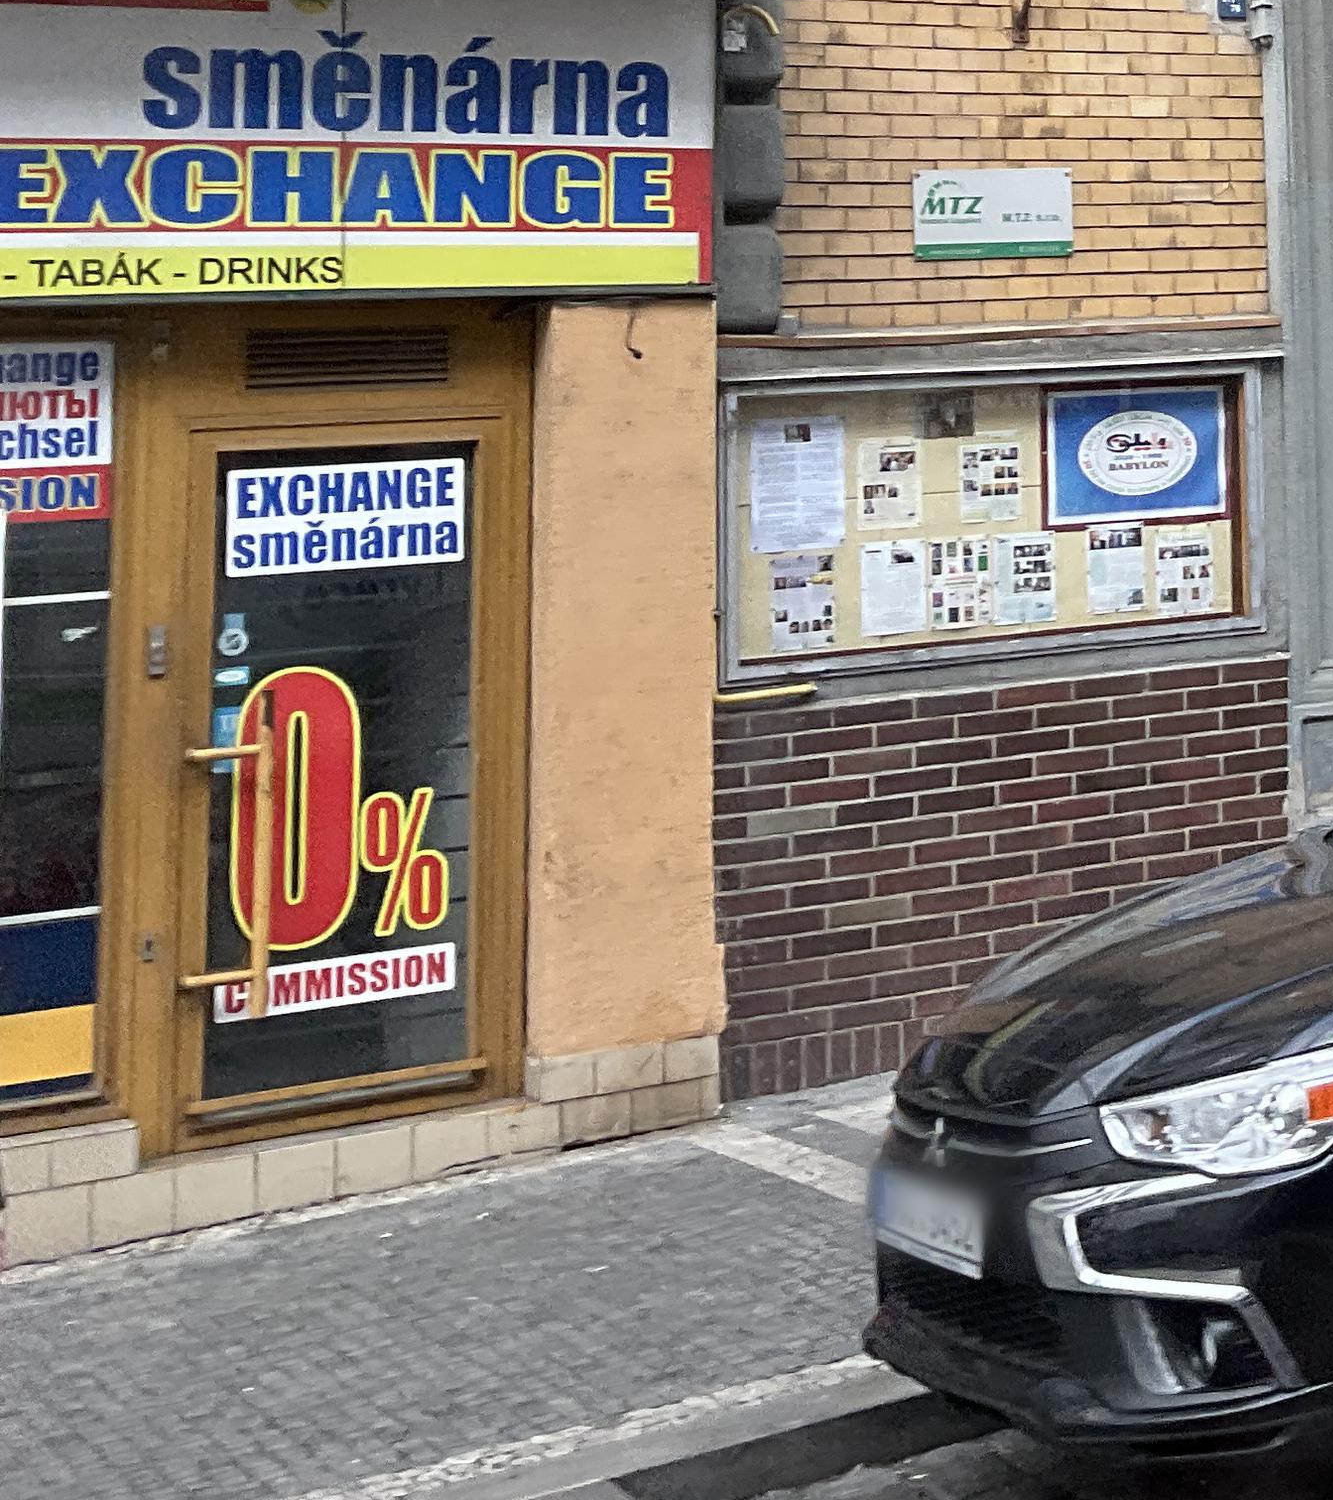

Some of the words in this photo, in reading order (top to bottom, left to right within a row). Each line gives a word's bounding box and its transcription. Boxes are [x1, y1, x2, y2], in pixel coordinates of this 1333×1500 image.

[142, 30, 671, 138] směnárna
[0, 143, 675, 230] EXCHANGE
[920, 196, 984, 216] MTZ
[29, 251, 163, 288] TABÁK
[199, 256, 344, 286] DRINKS
[0, 351, 100, 387] ange
[0, 420, 99, 461] chsel
[1108, 460, 1169, 472] BABYLON
[235, 465, 455, 519] EXCHANGE
[232, 516, 458, 569] směnárna
[229, 665, 450, 952] 0%
[225, 951, 447, 1014] CMMISSION
